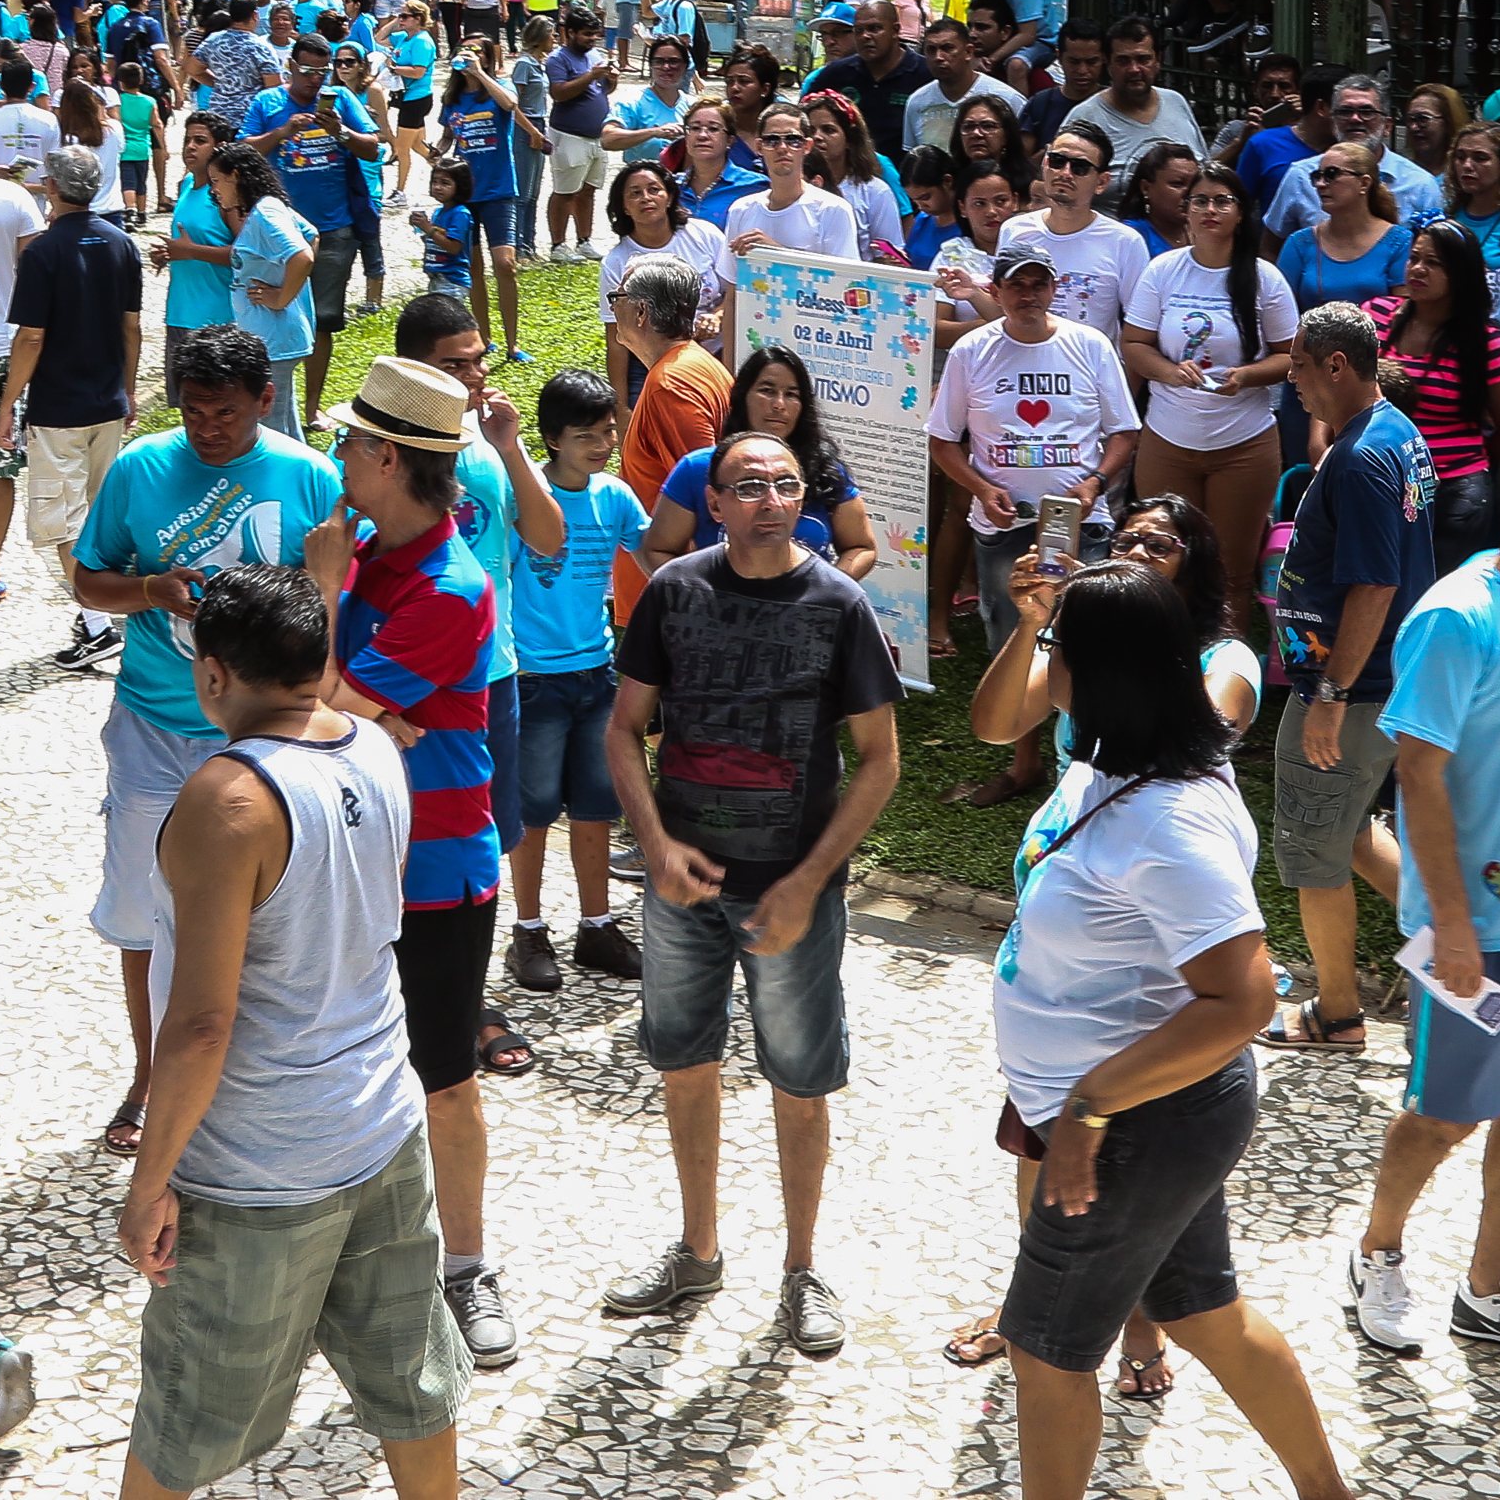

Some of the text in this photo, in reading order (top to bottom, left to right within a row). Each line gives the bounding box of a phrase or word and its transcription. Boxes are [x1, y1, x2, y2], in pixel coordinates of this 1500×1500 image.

[793, 325, 873, 351] 02 de Abril
[814, 378, 870, 406] UTISMO
[1018, 373, 1071, 395] AMO
[156, 477, 229, 547] Autismo
[187, 493, 253, 554] envolver
